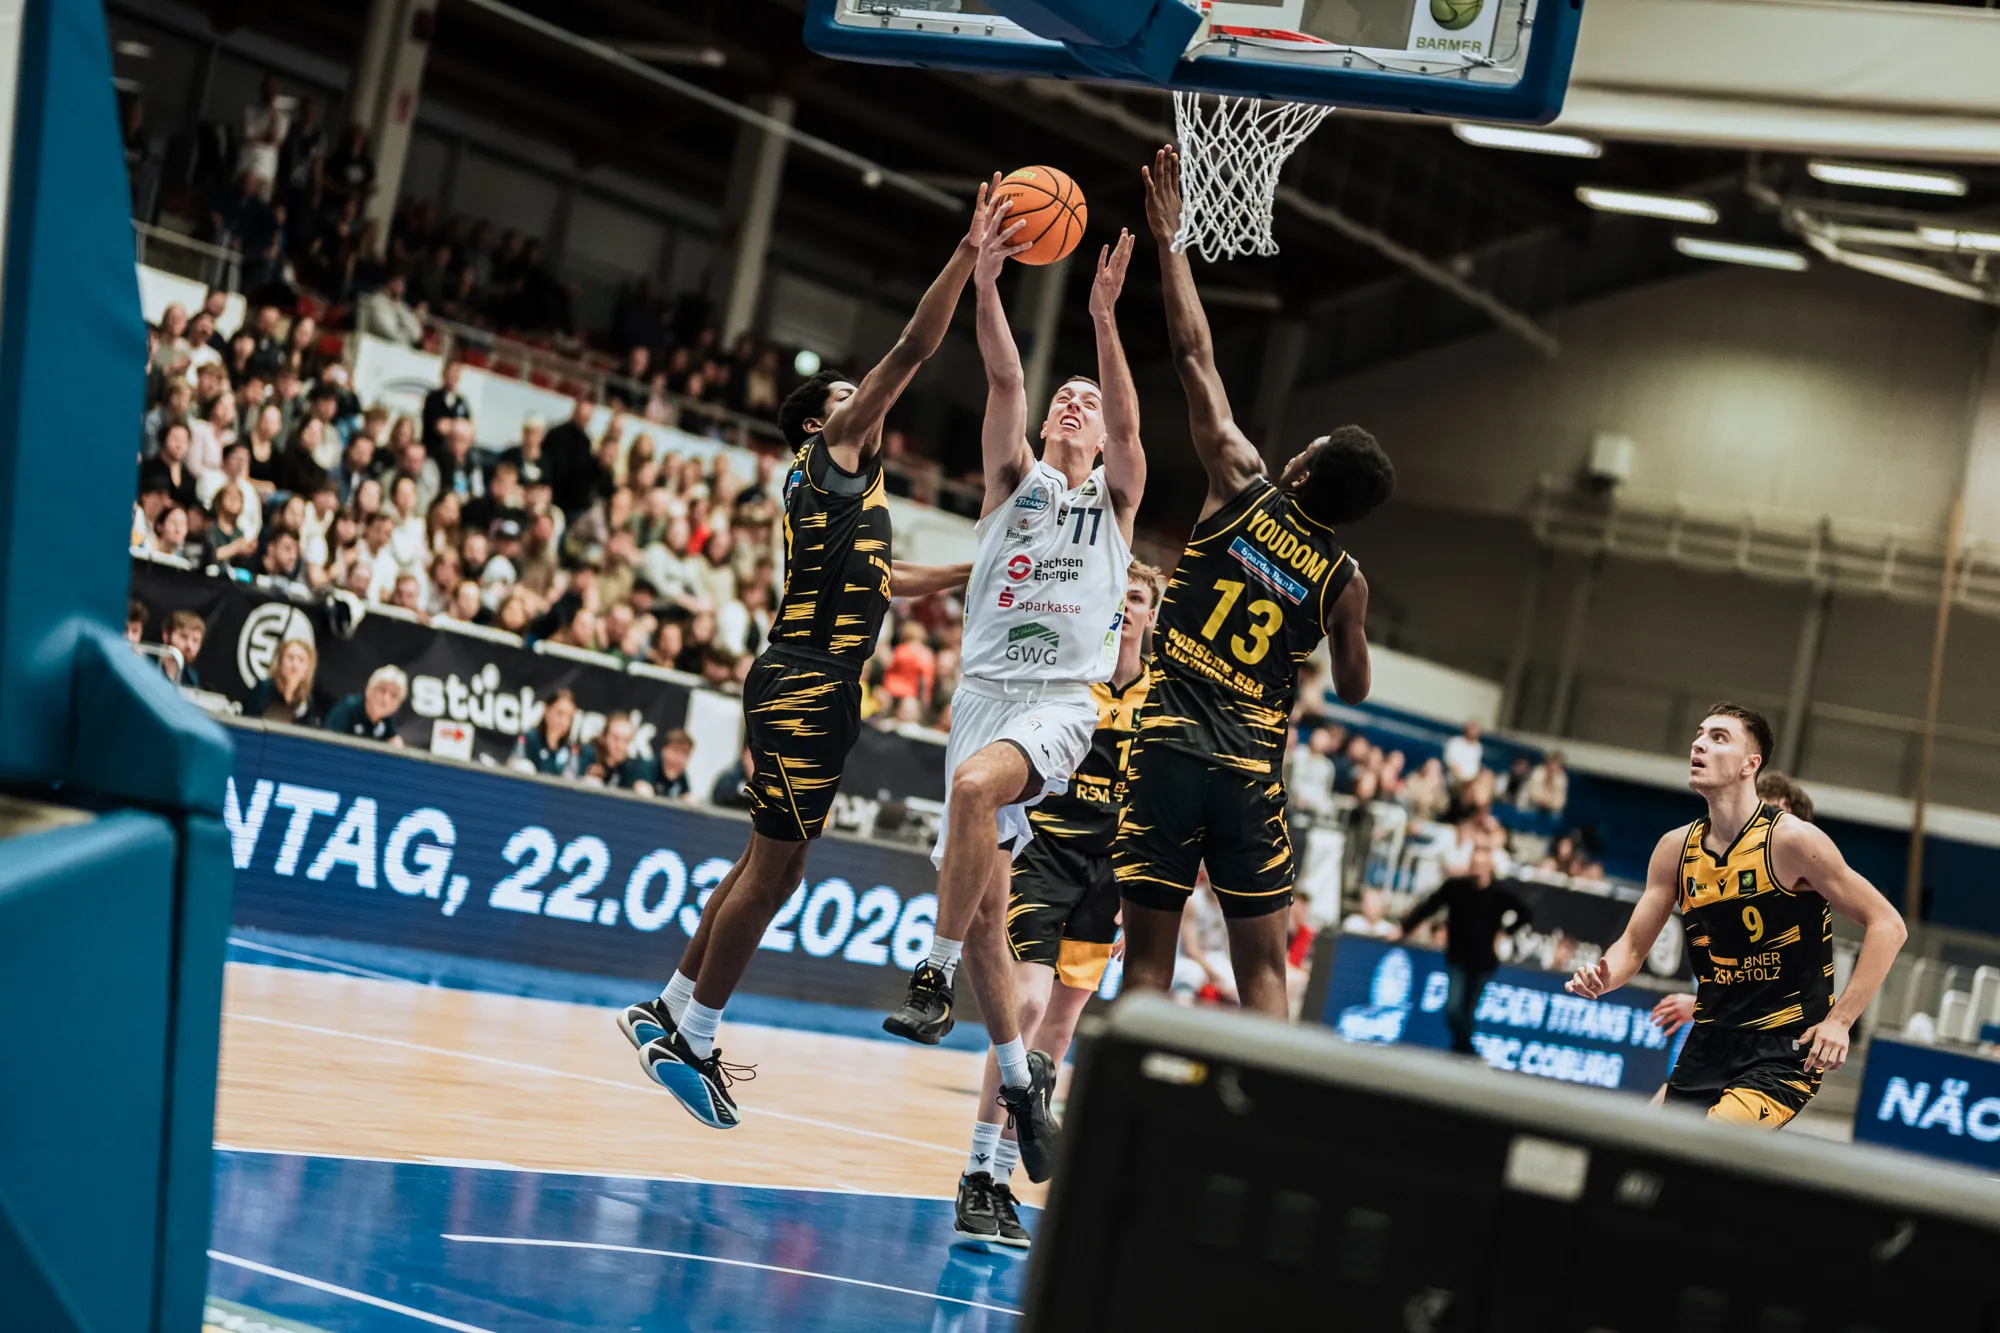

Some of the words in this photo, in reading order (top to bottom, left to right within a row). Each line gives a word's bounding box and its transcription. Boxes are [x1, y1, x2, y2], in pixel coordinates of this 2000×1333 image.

[1416, 37, 1482, 52] BARMER
[1070, 507, 1103, 546] 77
[1246, 508, 1329, 583] YOUDOM
[1035, 558, 1083, 569] Sachsen
[1240, 546, 1296, 593] Sparda-Bank
[1034, 568, 1079, 582] Energie
[1017, 601, 1081, 614] Sparkasse
[1200, 579, 1283, 665] 13
[1006, 645, 1057, 665] GWG
[1168, 627, 1233, 677] PORSCHE
[1233, 671, 1264, 695] BBA
[1076, 784, 1110, 803] RSM
[489, 826, 938, 972] 22.032026
[1741, 905, 1764, 943] 9
[1741, 952, 1781, 969] BNER
[1735, 967, 1781, 983] STOLZ
